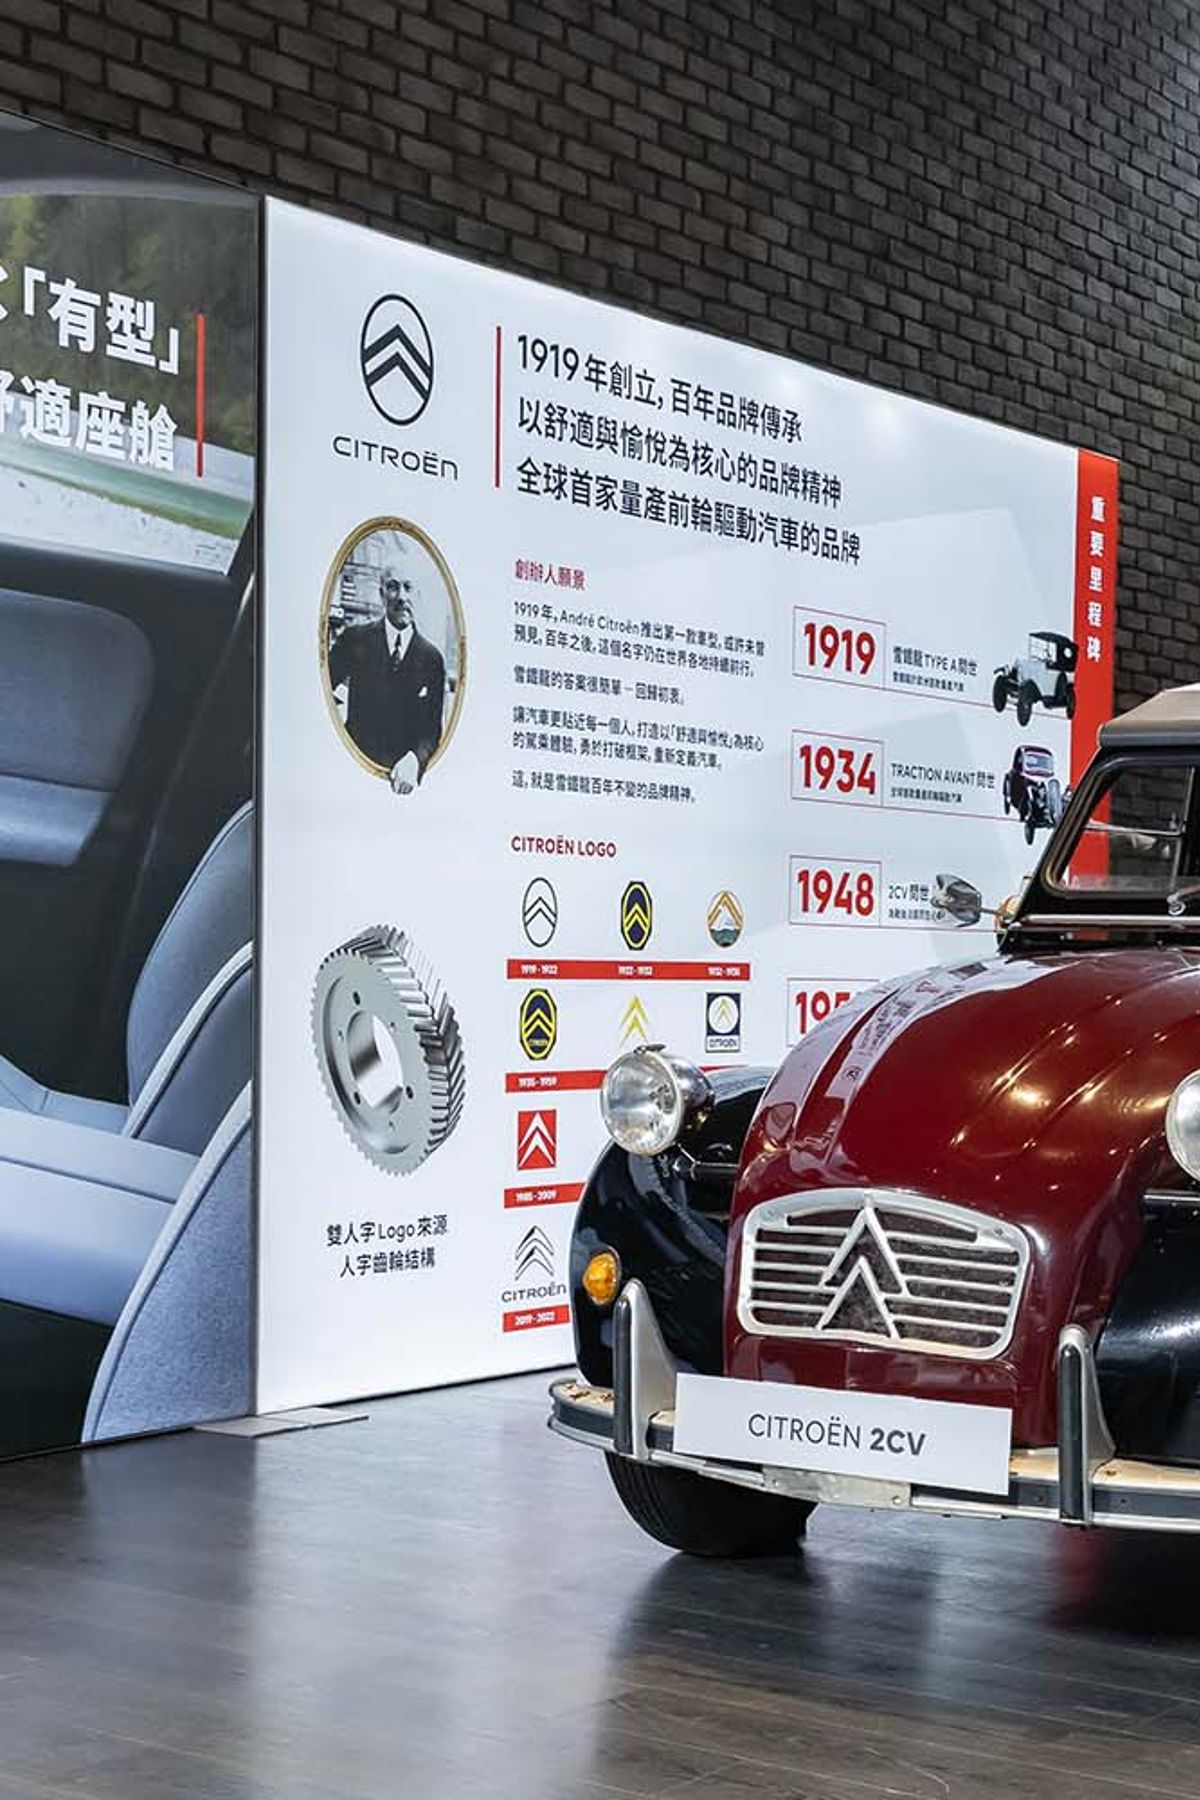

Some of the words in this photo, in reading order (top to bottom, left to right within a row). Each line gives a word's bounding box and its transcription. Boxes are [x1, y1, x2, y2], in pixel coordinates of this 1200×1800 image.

[0, 265, 179, 375] 「有型」
[518, 397, 842, 509] 以舒適與愉悅為核心的品牌精神
[517, 457, 860, 566] 全球首家量產前輪驅動汽車的品牌
[804, 622, 875, 674] 1919
[799, 745, 876, 795] 1934
[578, 840, 617, 857] LOGO
[798, 870, 874, 917] 1948
[748, 1414, 861, 1449] CITROËN
[869, 1428, 926, 1456] 2CV
